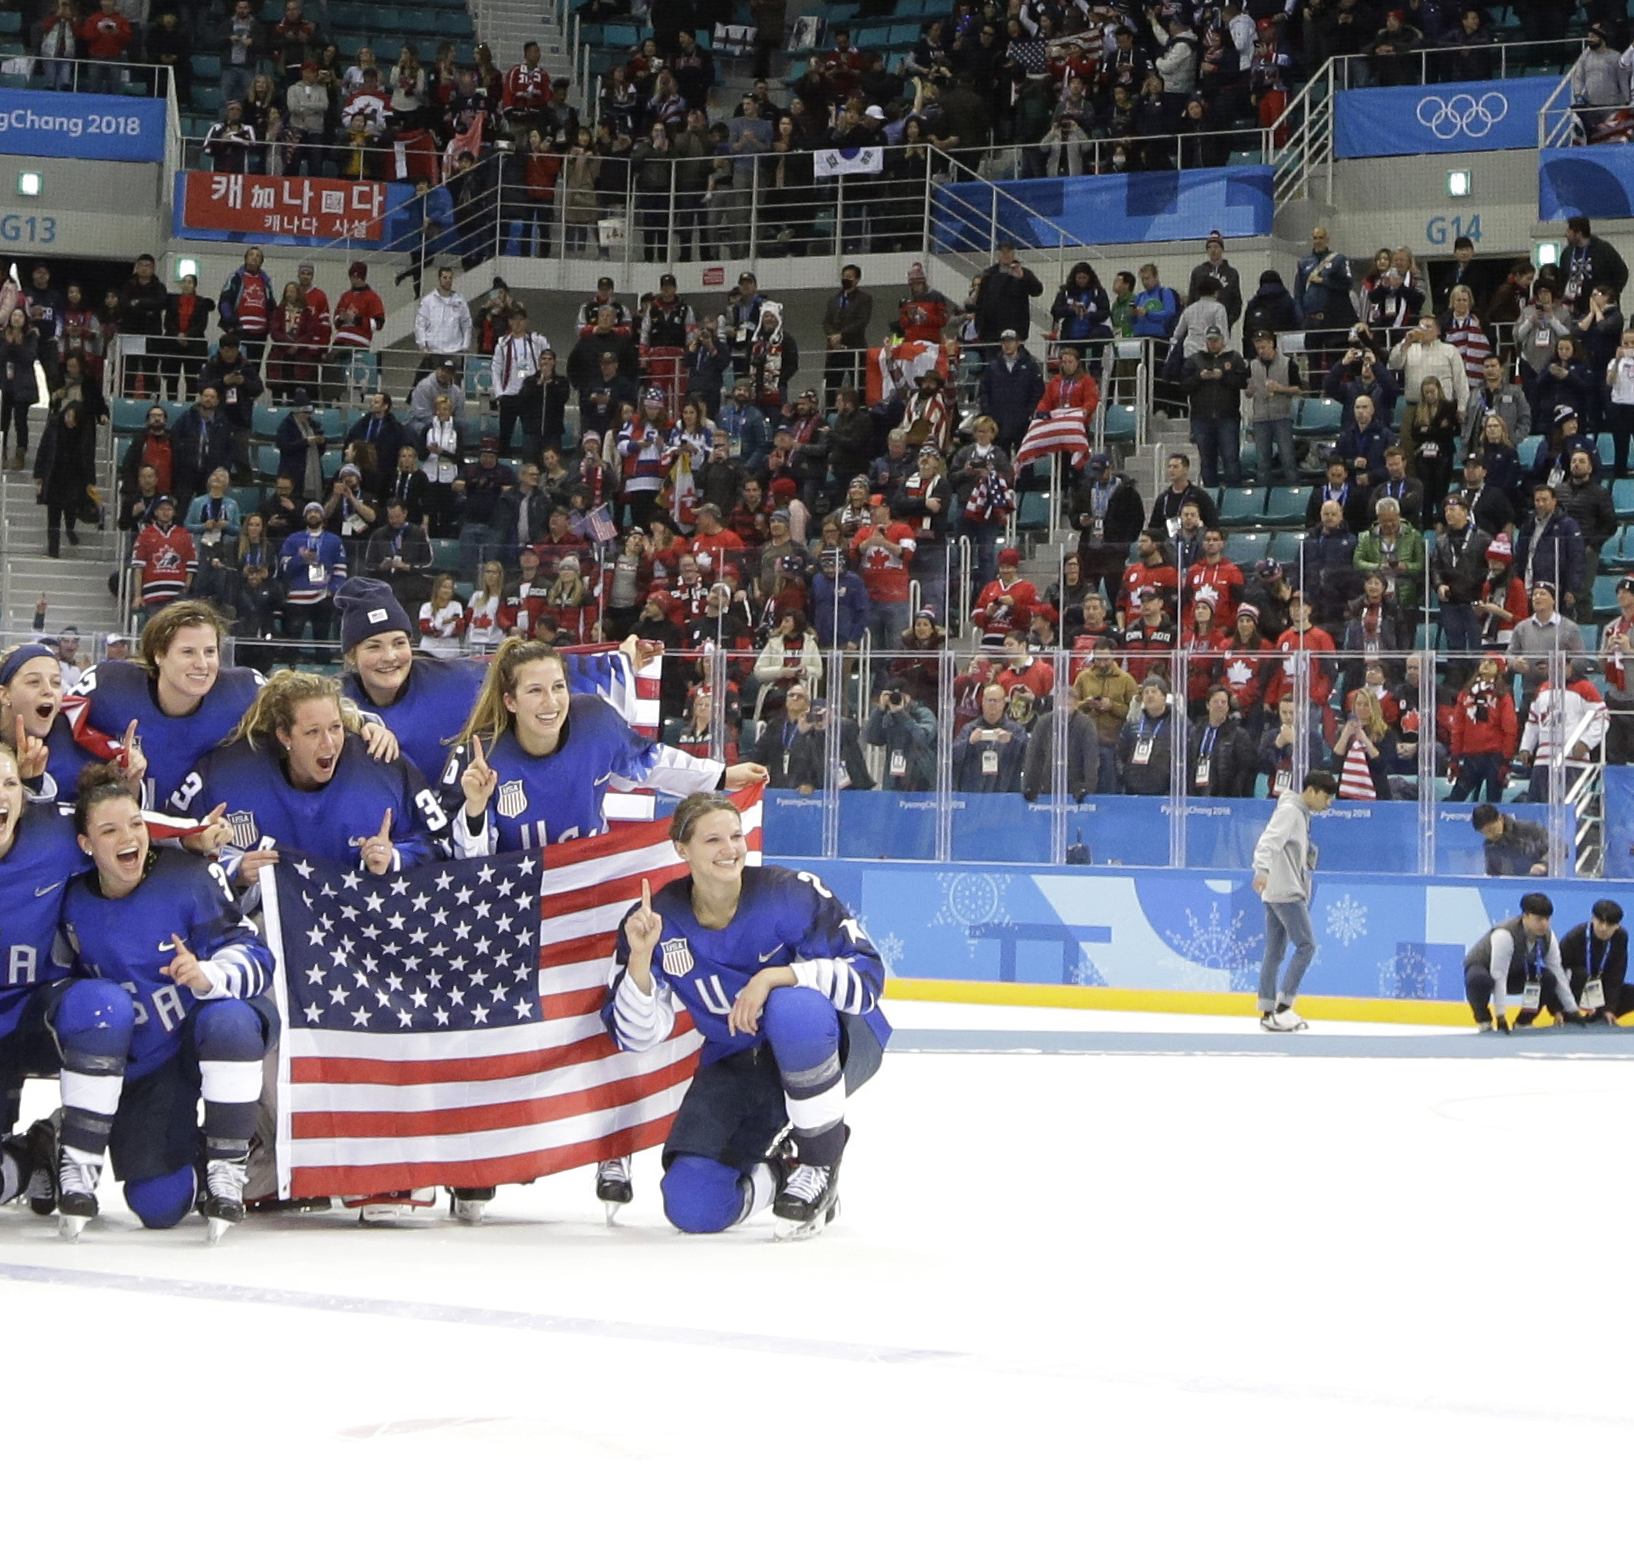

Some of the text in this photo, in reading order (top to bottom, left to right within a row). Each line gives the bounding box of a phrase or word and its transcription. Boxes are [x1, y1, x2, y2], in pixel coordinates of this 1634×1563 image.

[86, 114, 141, 135] 2018
[0, 214, 57, 243] G13
[264, 214, 318, 235] 캐나다
[1426, 214, 1483, 245] G14
[231, 812, 251, 824] USA
